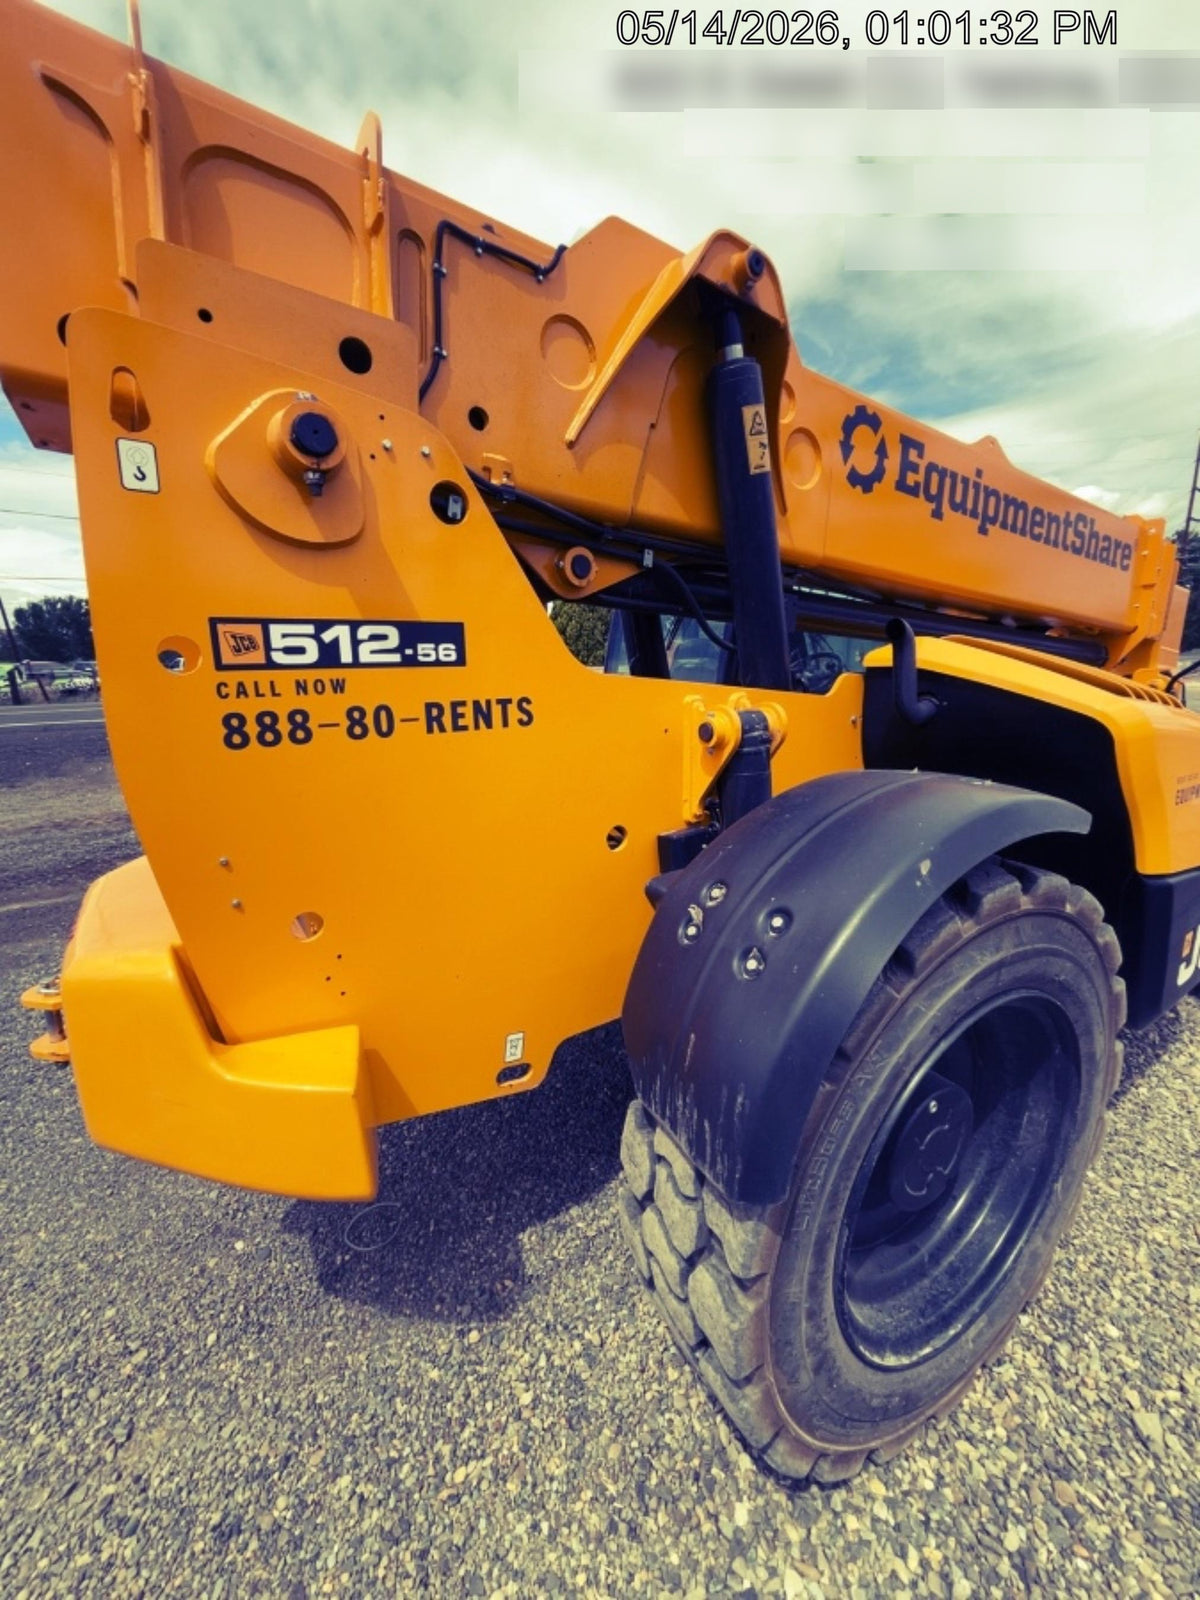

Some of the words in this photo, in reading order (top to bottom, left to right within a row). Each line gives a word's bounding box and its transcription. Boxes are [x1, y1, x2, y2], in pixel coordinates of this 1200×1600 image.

[894, 433, 1133, 572] EquipmentShare
[230, 633, 259, 654] JCB
[216, 680, 282, 699] CALL
[295, 678, 346, 696] NOW
[221, 697, 534, 750] 888-80-RENTS
[1177, 924, 1200, 986] J
